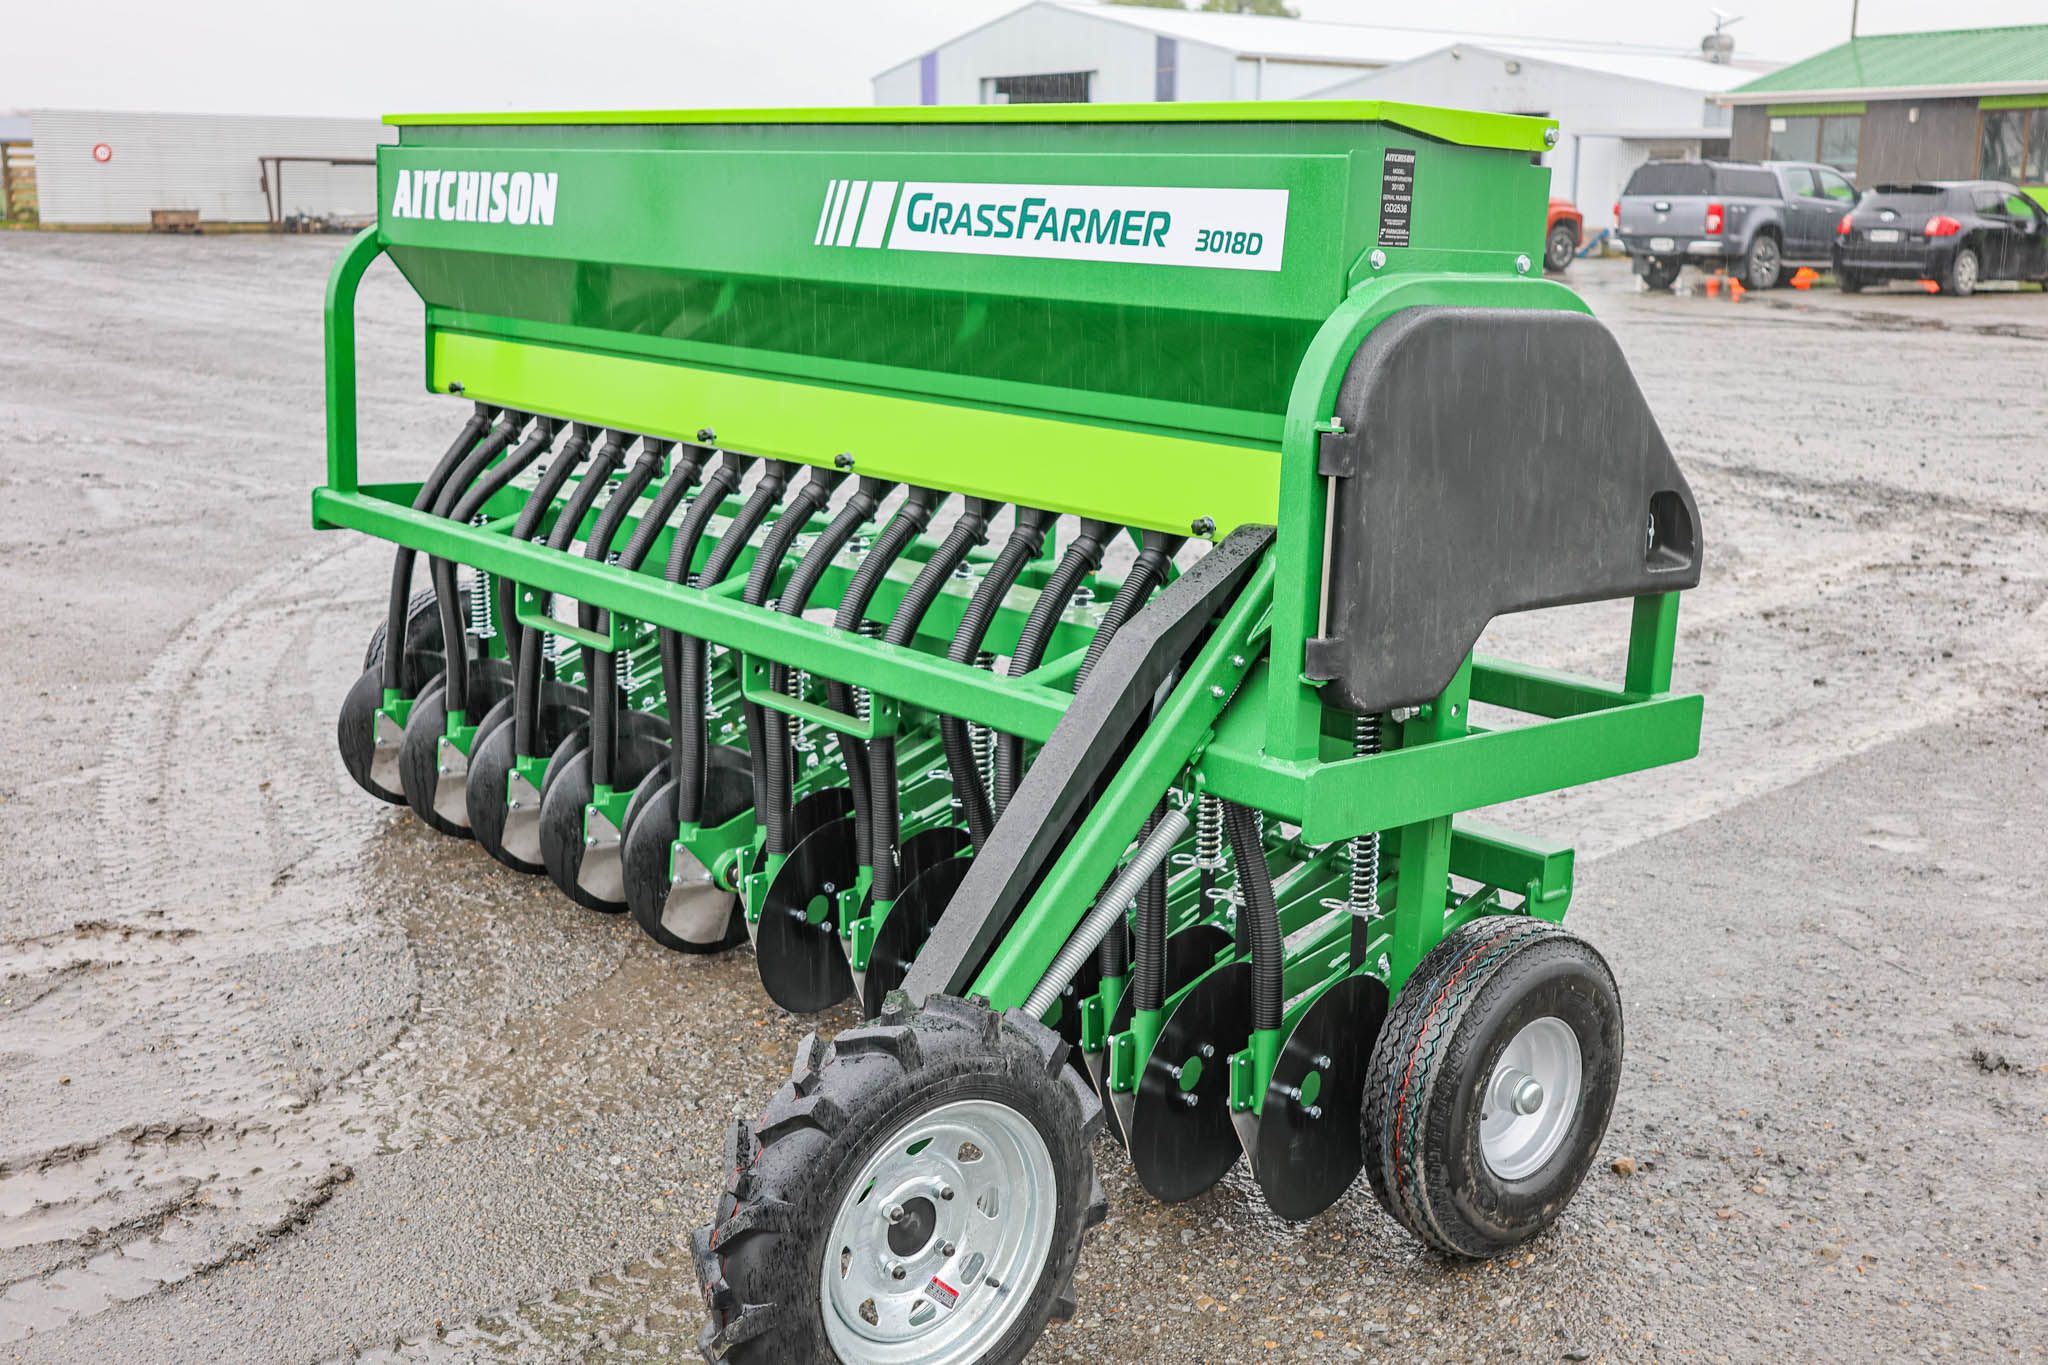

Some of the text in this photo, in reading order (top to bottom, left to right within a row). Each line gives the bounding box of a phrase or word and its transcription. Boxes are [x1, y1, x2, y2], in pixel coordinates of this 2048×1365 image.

[1385, 153, 1415, 163] AITCHISON
[392, 169, 558, 225] AITCHISON
[1194, 229, 1264, 256] 3018D
